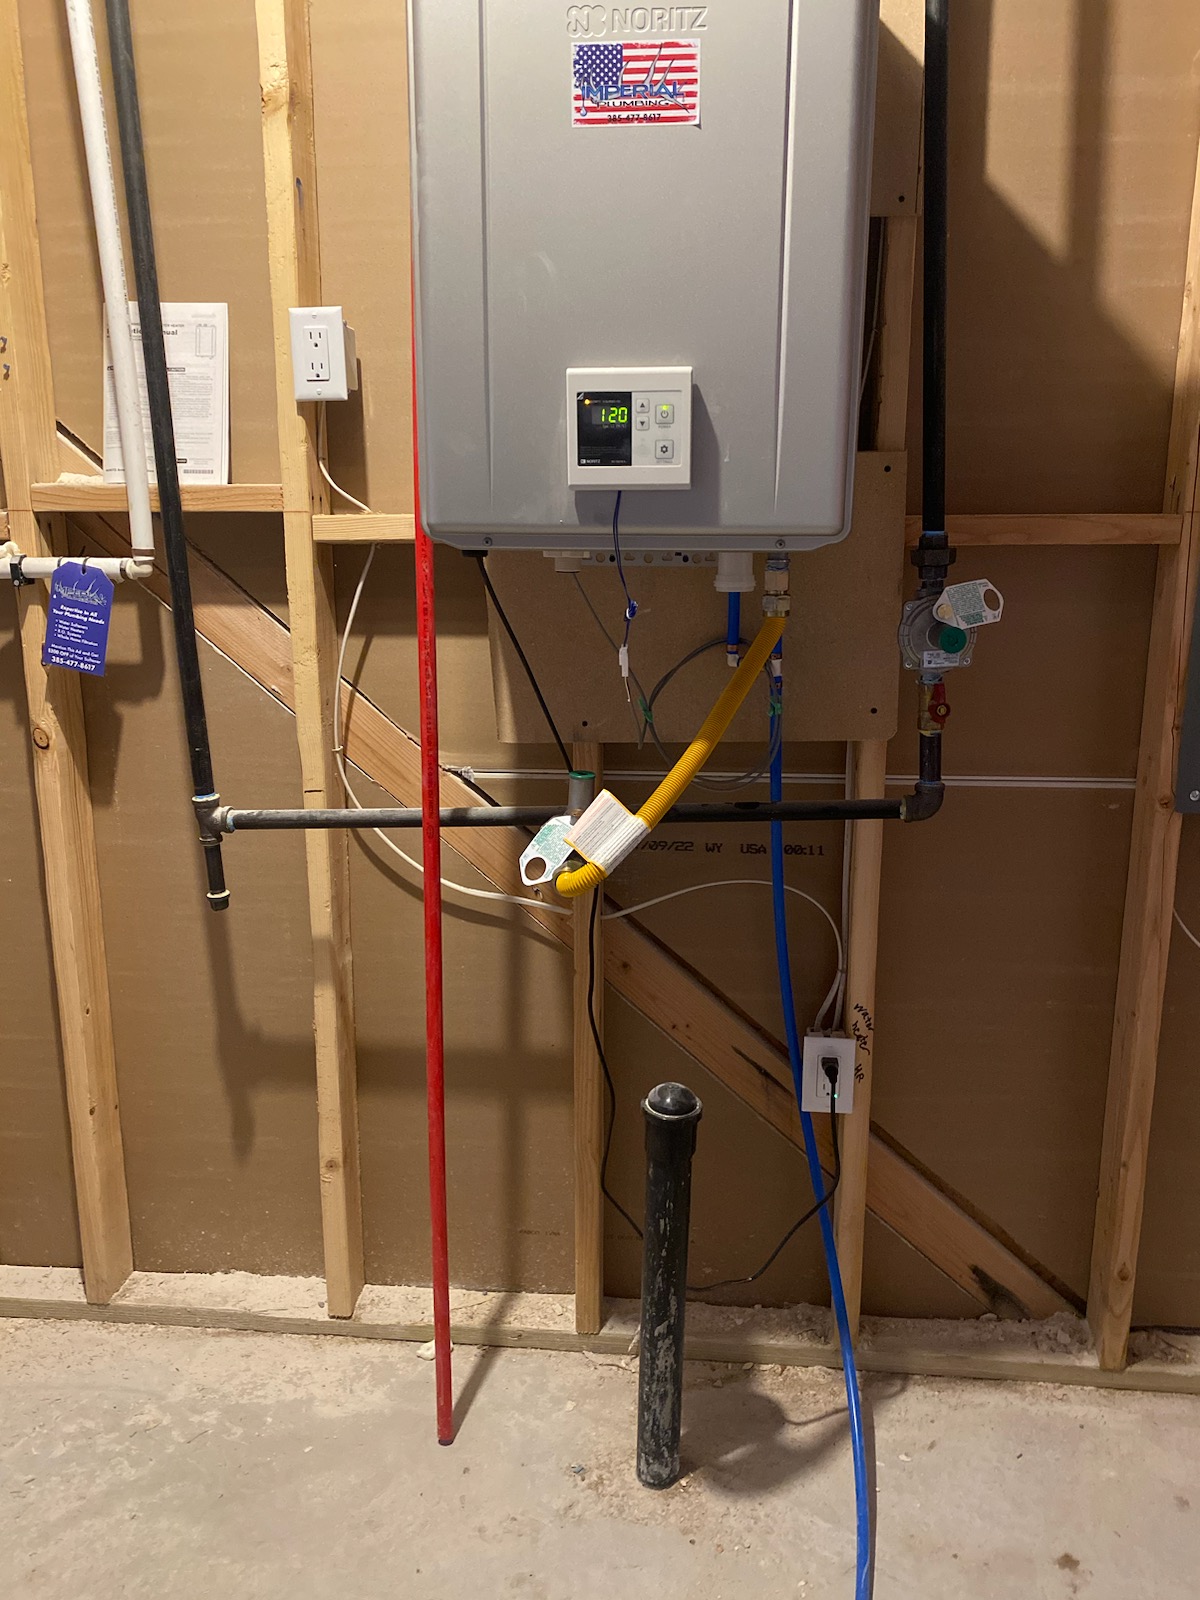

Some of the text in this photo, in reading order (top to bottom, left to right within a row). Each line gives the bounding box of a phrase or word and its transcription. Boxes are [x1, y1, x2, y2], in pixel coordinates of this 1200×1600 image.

[611, 6, 708, 33] NORITZ
[581, 81, 685, 100] IMPERIAL
[597, 99, 670, 108] PLUMBING
[607, 113, 661, 123] 385-477-8617
[601, 406, 628, 423] 120
[60, 605, 83, 614] Expertise
[64, 611, 88, 622] Plumbing
[88, 617, 105, 625] Needs
[51, 656, 95, 670] 385-477-8617
[635, 840, 825, 857] /09/22 WY USA 00:11
